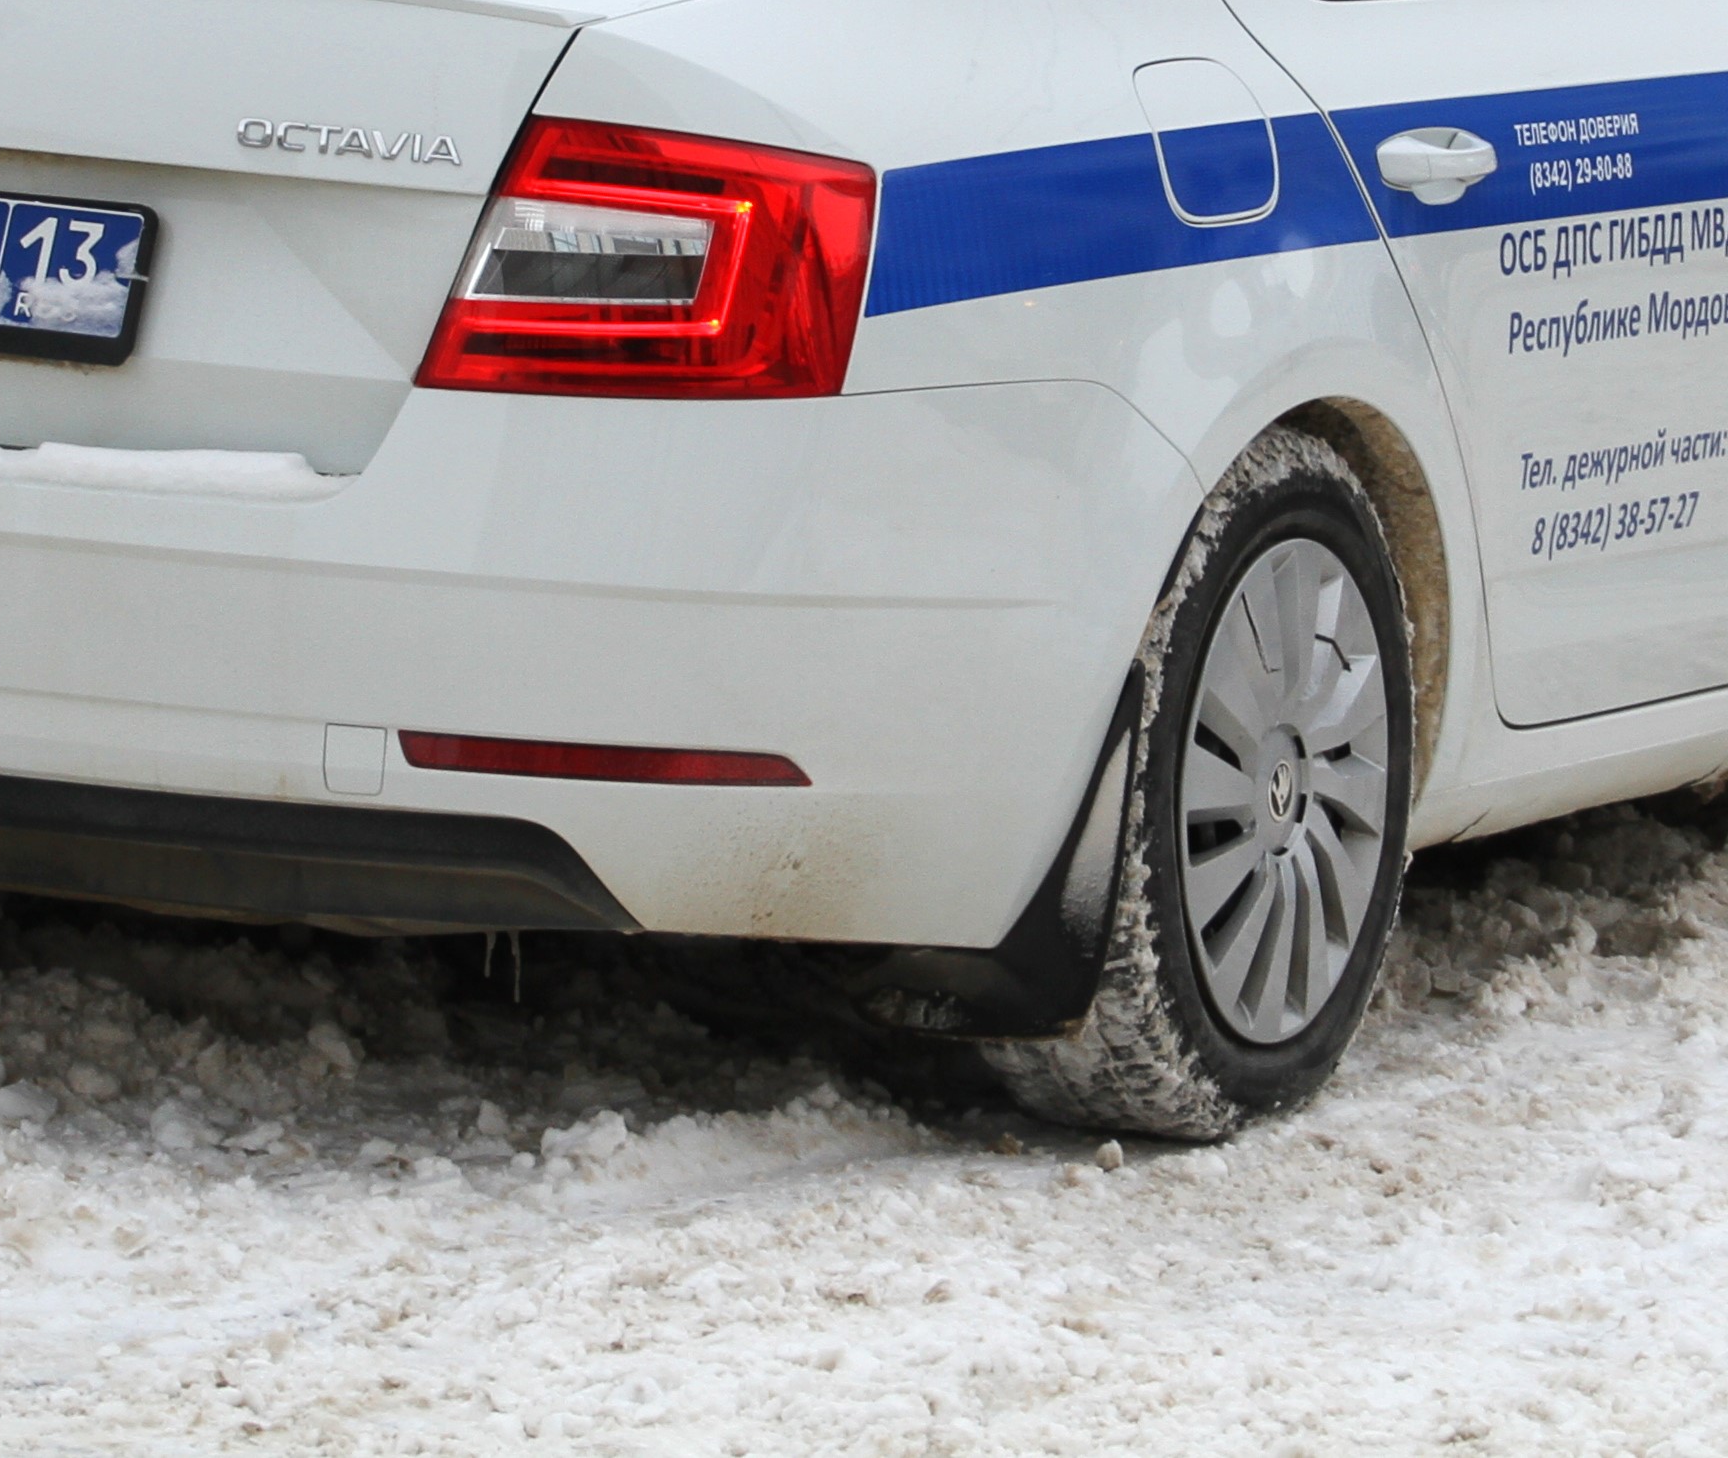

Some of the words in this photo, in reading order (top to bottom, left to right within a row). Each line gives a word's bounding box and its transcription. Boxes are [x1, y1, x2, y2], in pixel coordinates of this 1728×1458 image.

[237, 117, 462, 167] OCTAVIA
[1513, 119, 1577, 146] ТЕЛЕФОН
[1579, 112, 1639, 144] ДОВЕРИЯ
[1530, 158, 1573, 196] (8342)
[1575, 152, 1633, 184] 29-80-88
[19, 217, 106, 287] 13
[1500, 229, 1547, 276] ОСБ
[1553, 221, 1602, 279] ДПС
[1609, 212, 1685, 266] ГИБДД
[1509, 299, 1641, 357] Республике
[1522, 453, 1557, 491] Тел.
[1562, 428, 1667, 491] дежурной
[1671, 430, 1728, 464] части:
[1531, 517, 1546, 556] 8
[1548, 503, 1612, 560] (8342)
[1614, 492, 1699, 541] 38-57-27
